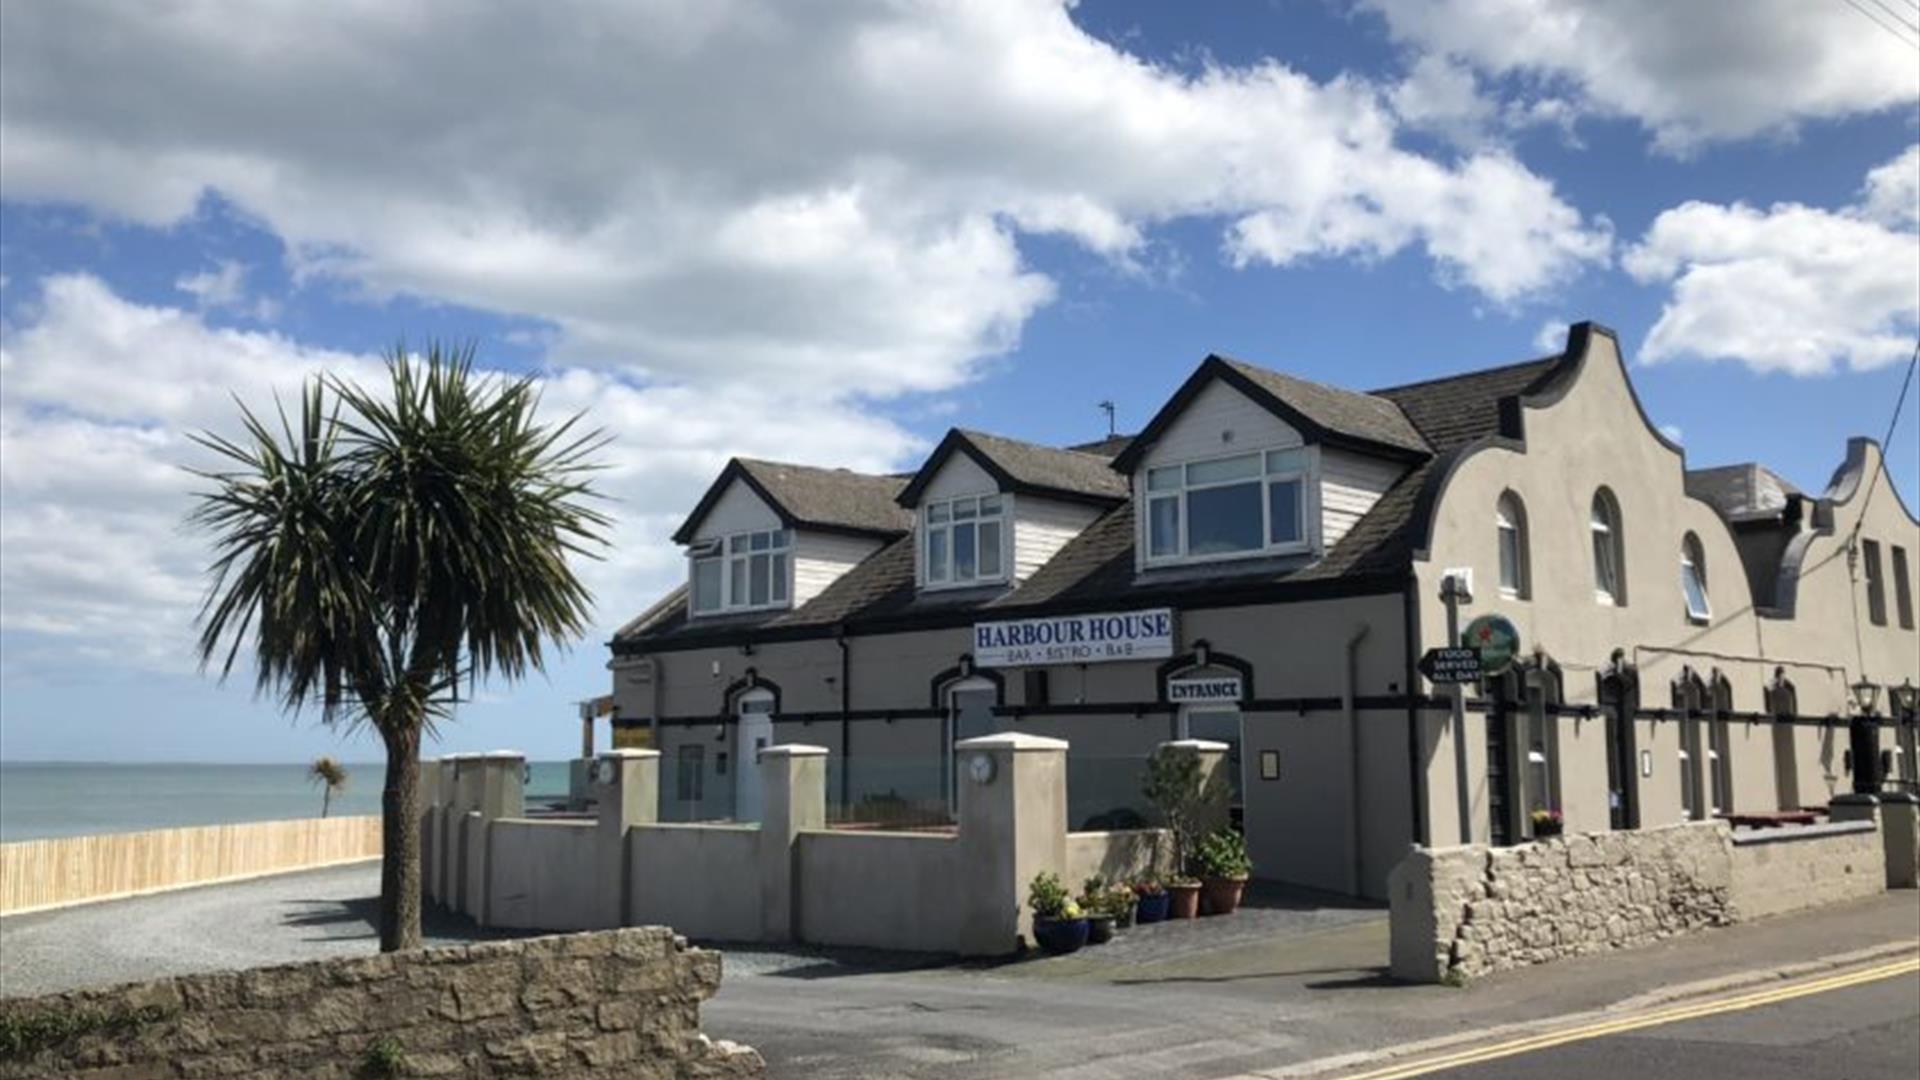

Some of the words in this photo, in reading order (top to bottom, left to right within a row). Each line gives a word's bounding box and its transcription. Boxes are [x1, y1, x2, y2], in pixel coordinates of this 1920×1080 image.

[978, 620, 1084, 648] HARBOUR
[1089, 613, 1170, 640] HOUSE
[1007, 650, 1032, 662] BAR
[1046, 646, 1092, 661] BISTRO
[1437, 650, 1473, 659] FOOD
[1433, 660, 1478, 669] SERVED
[1433, 672, 1453, 680] ALL
[1456, 671, 1480, 680] DAY
[1172, 682, 1238, 699] ENTRANCE
